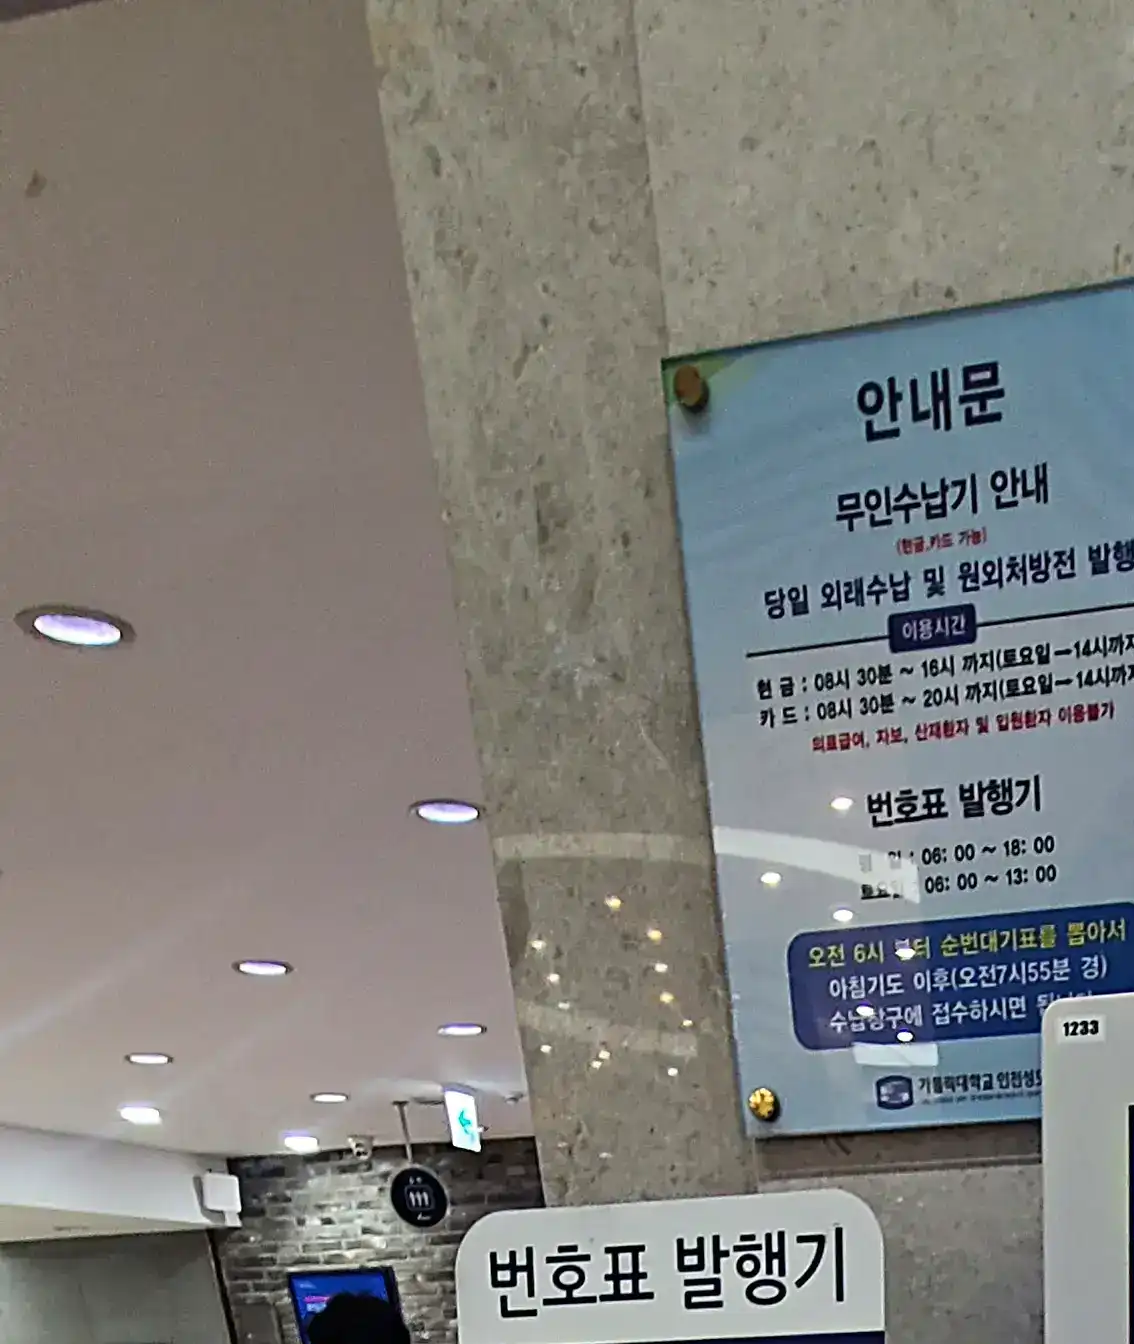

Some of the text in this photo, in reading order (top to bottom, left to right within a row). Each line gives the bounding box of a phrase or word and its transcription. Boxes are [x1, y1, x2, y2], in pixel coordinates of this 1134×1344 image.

[856, 361, 1005, 442] 안내문
[836, 462, 1049, 531] 무인수납기 안내
[764, 584, 810, 619] 당일
[820, 570, 911, 612] 외래수납
[923, 565, 946, 598] 및
[958, 547, 1076, 592] 원외처방전
[902, 614, 967, 641] 이용시간
[857, 664, 893, 686] 30분
[921, 655, 956, 678] 16시
[859, 693, 895, 715] 30분
[923, 684, 959, 708] 20시
[867, 774, 1042, 828] 번호표 발행기
[808, 943, 845, 968] 오전
[854, 940, 884, 964] 6시
[940, 924, 1056, 957] 순번대기표를
[1067, 917, 1126, 947] 뽑아서
[829, 954, 1108, 1000] 아침기도 이후(오전7시55분 경)
[931, 995, 1028, 1026] 접수하시면
[1063, 1020, 1100, 1036] 1233
[489, 1226, 846, 1319] 번호표 발행기
